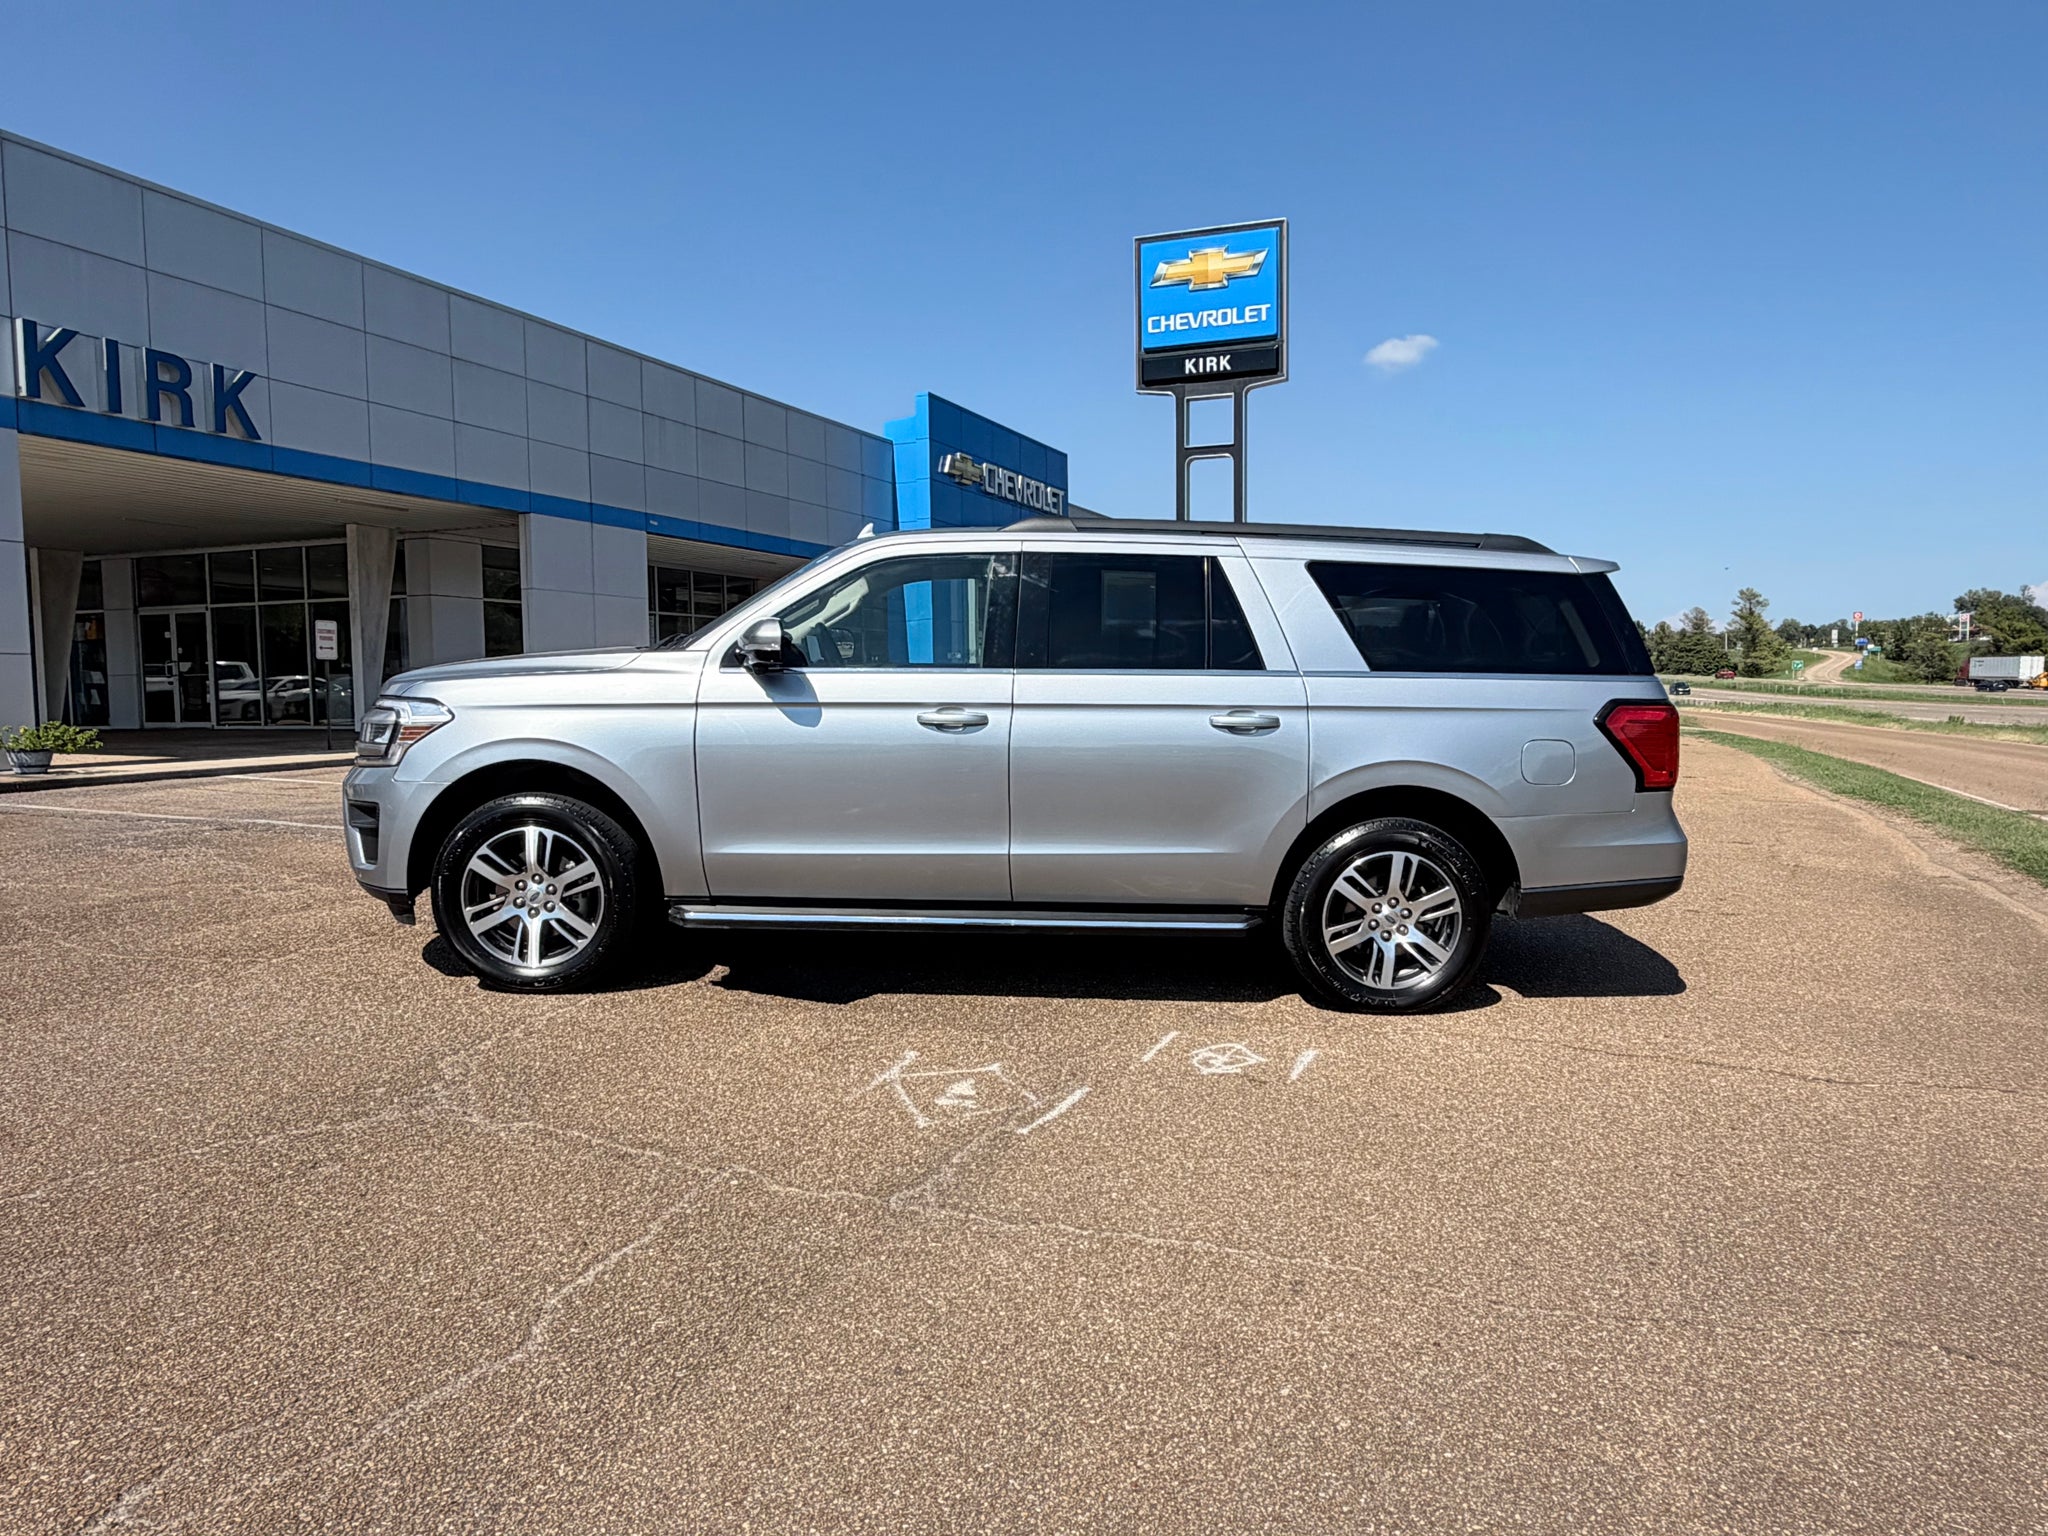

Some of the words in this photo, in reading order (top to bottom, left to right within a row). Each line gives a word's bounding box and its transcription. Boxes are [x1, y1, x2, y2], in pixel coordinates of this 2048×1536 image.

[1147, 304, 1271, 333] CHEVROLET
[15, 317, 262, 440] KIRK
[1185, 355, 1232, 374] KIRK
[982, 462, 1065, 516] CHEVROLET
